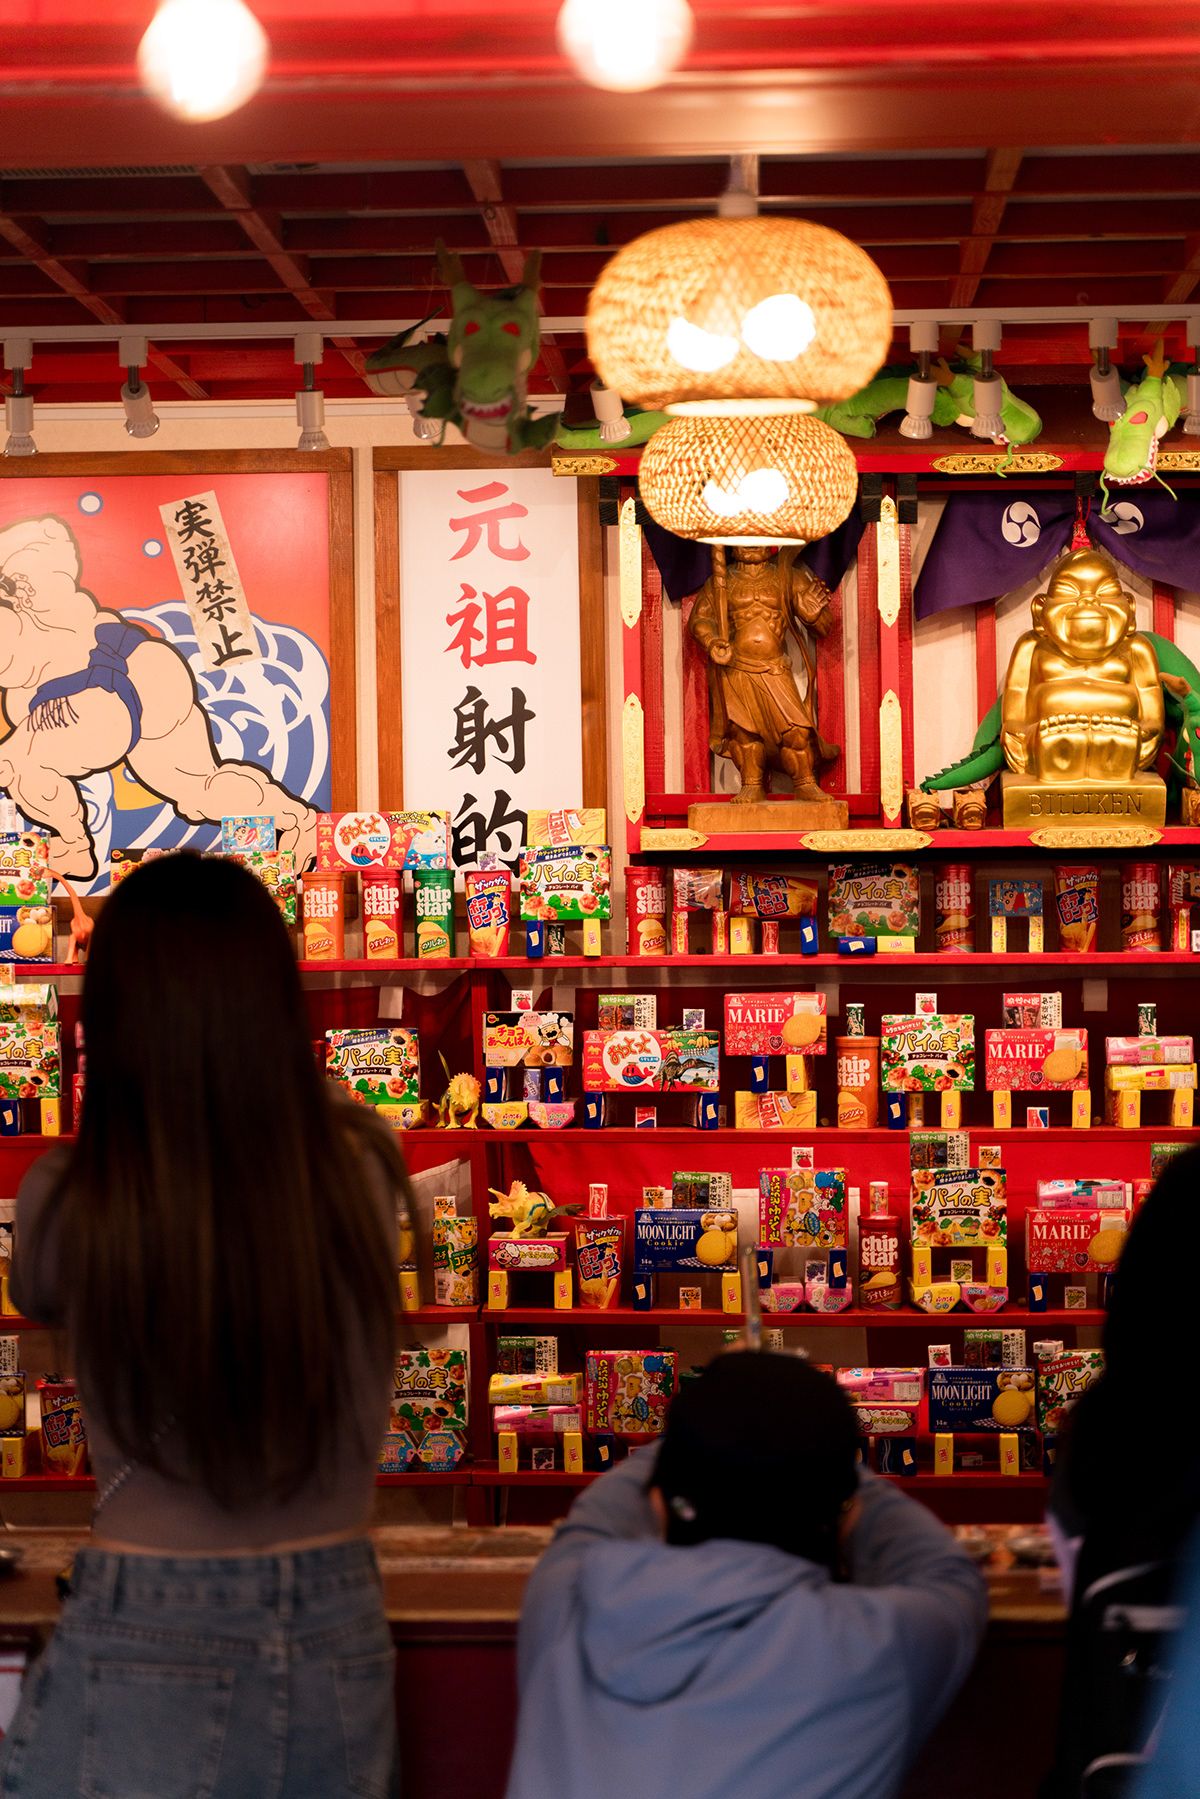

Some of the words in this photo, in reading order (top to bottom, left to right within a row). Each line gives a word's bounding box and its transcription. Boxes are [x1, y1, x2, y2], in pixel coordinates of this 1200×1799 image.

[174, 499, 254, 668] 実弾禁止
[443, 480, 538, 878] 元祖射的
[1027, 793, 1144, 817] BILLIKEN
[339, 814, 381, 845] おっとっと
[534, 862, 595, 883] パイの実
[303, 887, 339, 904] chip
[364, 885, 399, 902] chip
[416, 885, 451, 902] chip
[842, 879, 904, 900] パイの実
[936, 880, 971, 896] chip
[1122, 879, 1158, 896] chip
[303, 902, 339, 918] star
[364, 901, 400, 916] star
[416, 901, 452, 916] star
[468, 897, 488, 915] ポテ
[936, 894, 971, 910] star
[1059, 893, 1080, 911] ポテ
[1122, 895, 1158, 910] star
[471, 905, 503, 927] ロング
[1062, 902, 1093, 922] ロング
[728, 1008, 785, 1024] MARIE
[497, 1026, 525, 1037] チョコ
[607, 1033, 652, 1065] おっとっと
[896, 1031, 960, 1052] パイの実
[340, 1045, 403, 1067] パイの実
[988, 1043, 1046, 1059] MARIE
[837, 1056, 870, 1073] chip
[927, 1185, 993, 1207] パイの実
[768, 1175, 781, 1243] たべっ子どうぶつ
[1032, 1225, 1091, 1240] MARIE
[862, 1235, 898, 1252] chip
[580, 1248, 601, 1265] ポテ
[862, 1251, 898, 1266] star
[583, 1257, 615, 1279] ロング
[596, 1359, 609, 1428] たべっ子どうぶつ
